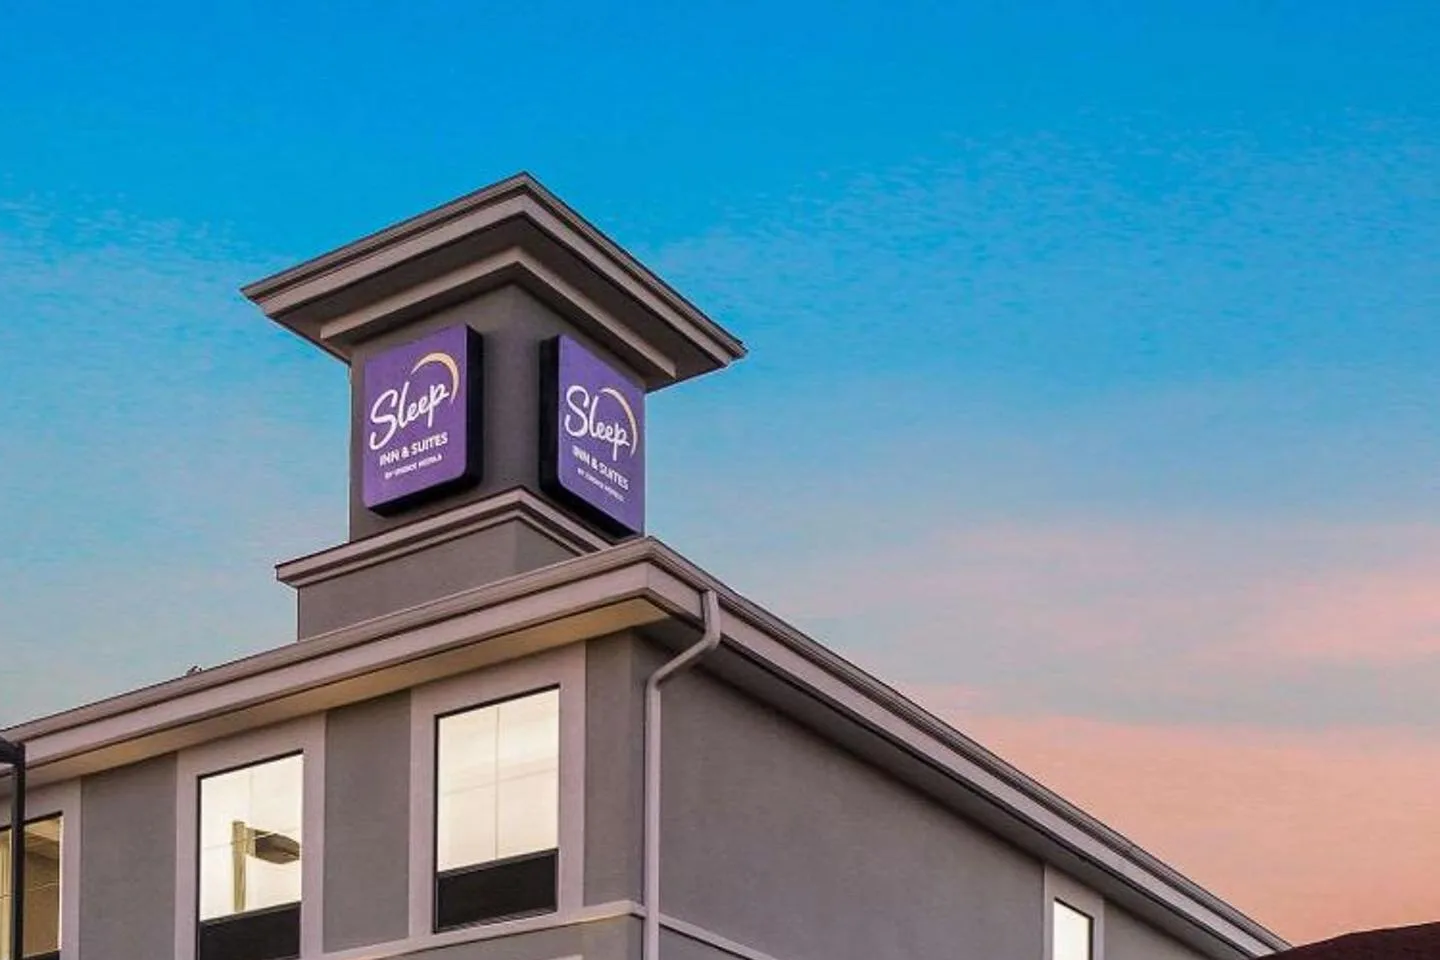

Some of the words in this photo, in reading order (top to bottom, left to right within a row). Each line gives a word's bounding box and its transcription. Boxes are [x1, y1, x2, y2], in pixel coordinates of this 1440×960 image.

[369, 381, 450, 450] Sleep
[380, 448, 400, 467] INN
[401, 446, 410, 459] &
[411, 431, 449, 456] SUITES
[564, 385, 631, 461] Sleep
